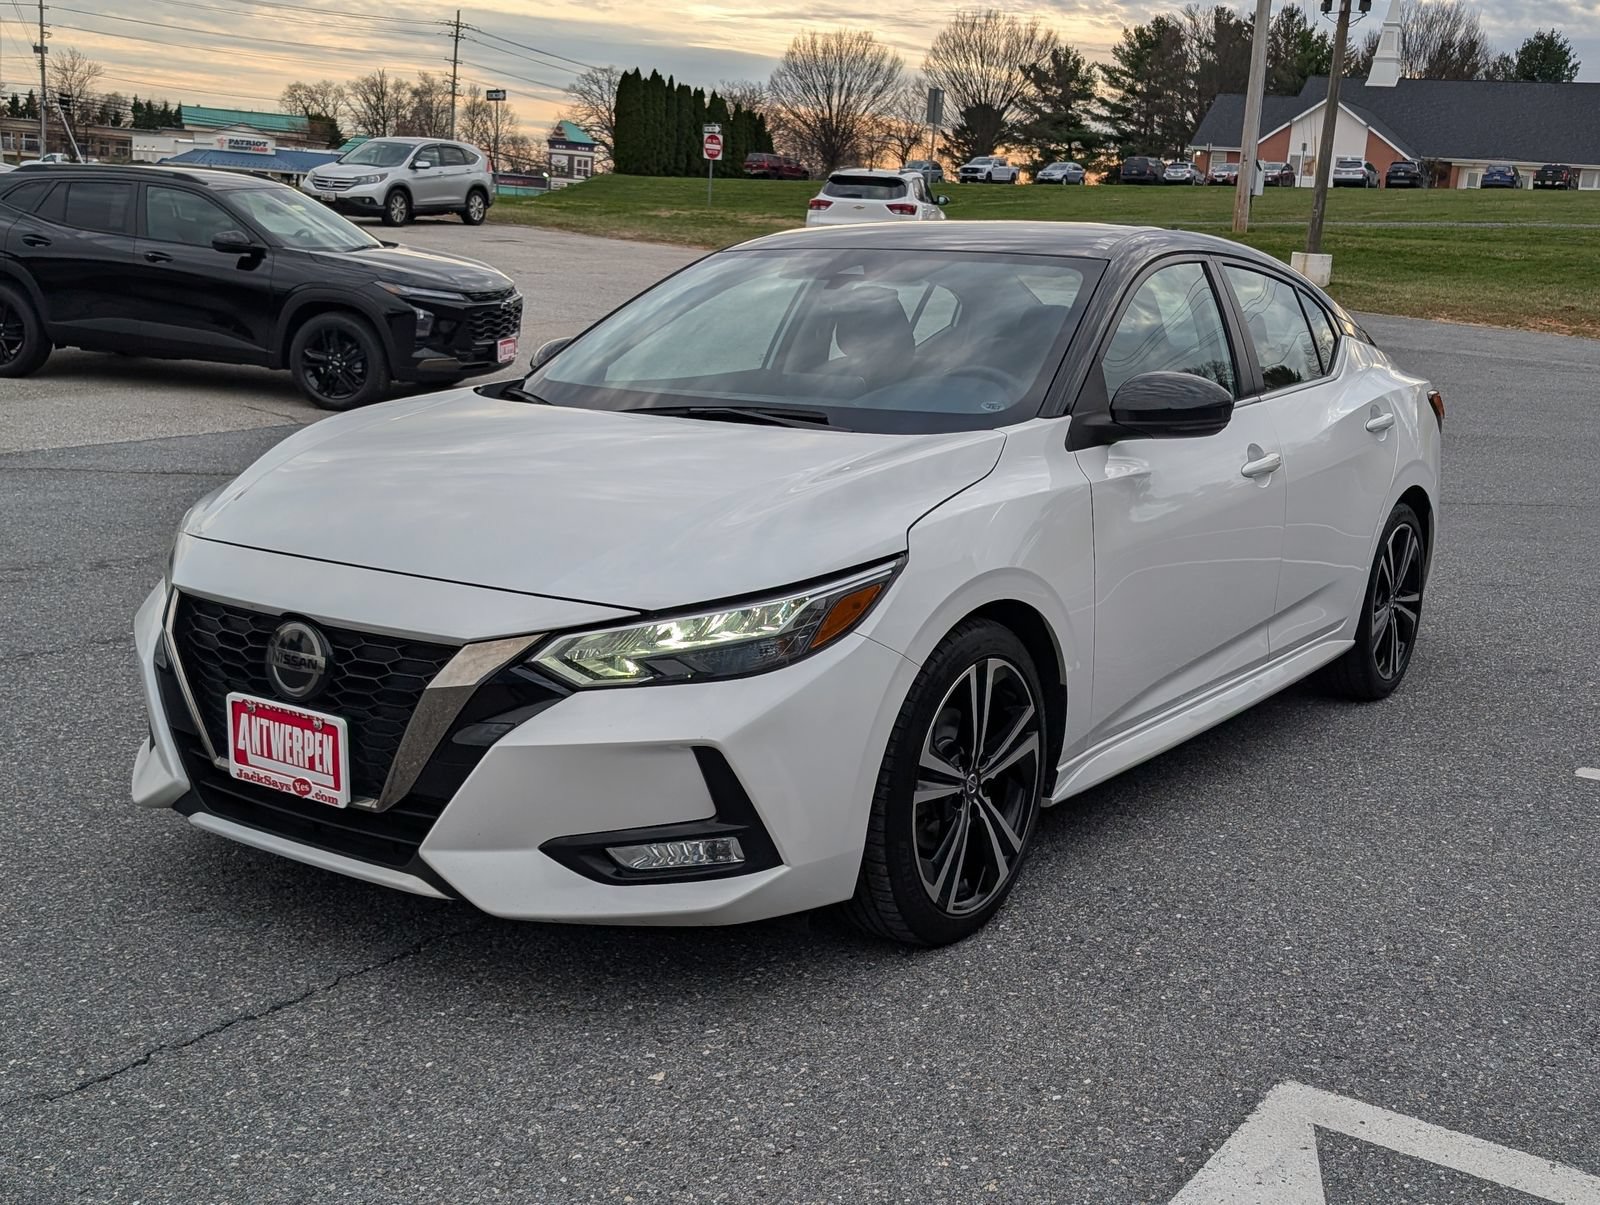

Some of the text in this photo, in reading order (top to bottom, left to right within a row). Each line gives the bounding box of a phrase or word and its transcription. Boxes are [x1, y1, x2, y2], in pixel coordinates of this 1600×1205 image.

[228, 139, 267, 147] PATRIOT
[272, 652, 318, 670] NISSAN
[237, 712, 334, 775] ANTWERPEN
[236, 768, 291, 791] JackSays
[294, 781, 310, 792] Yes
